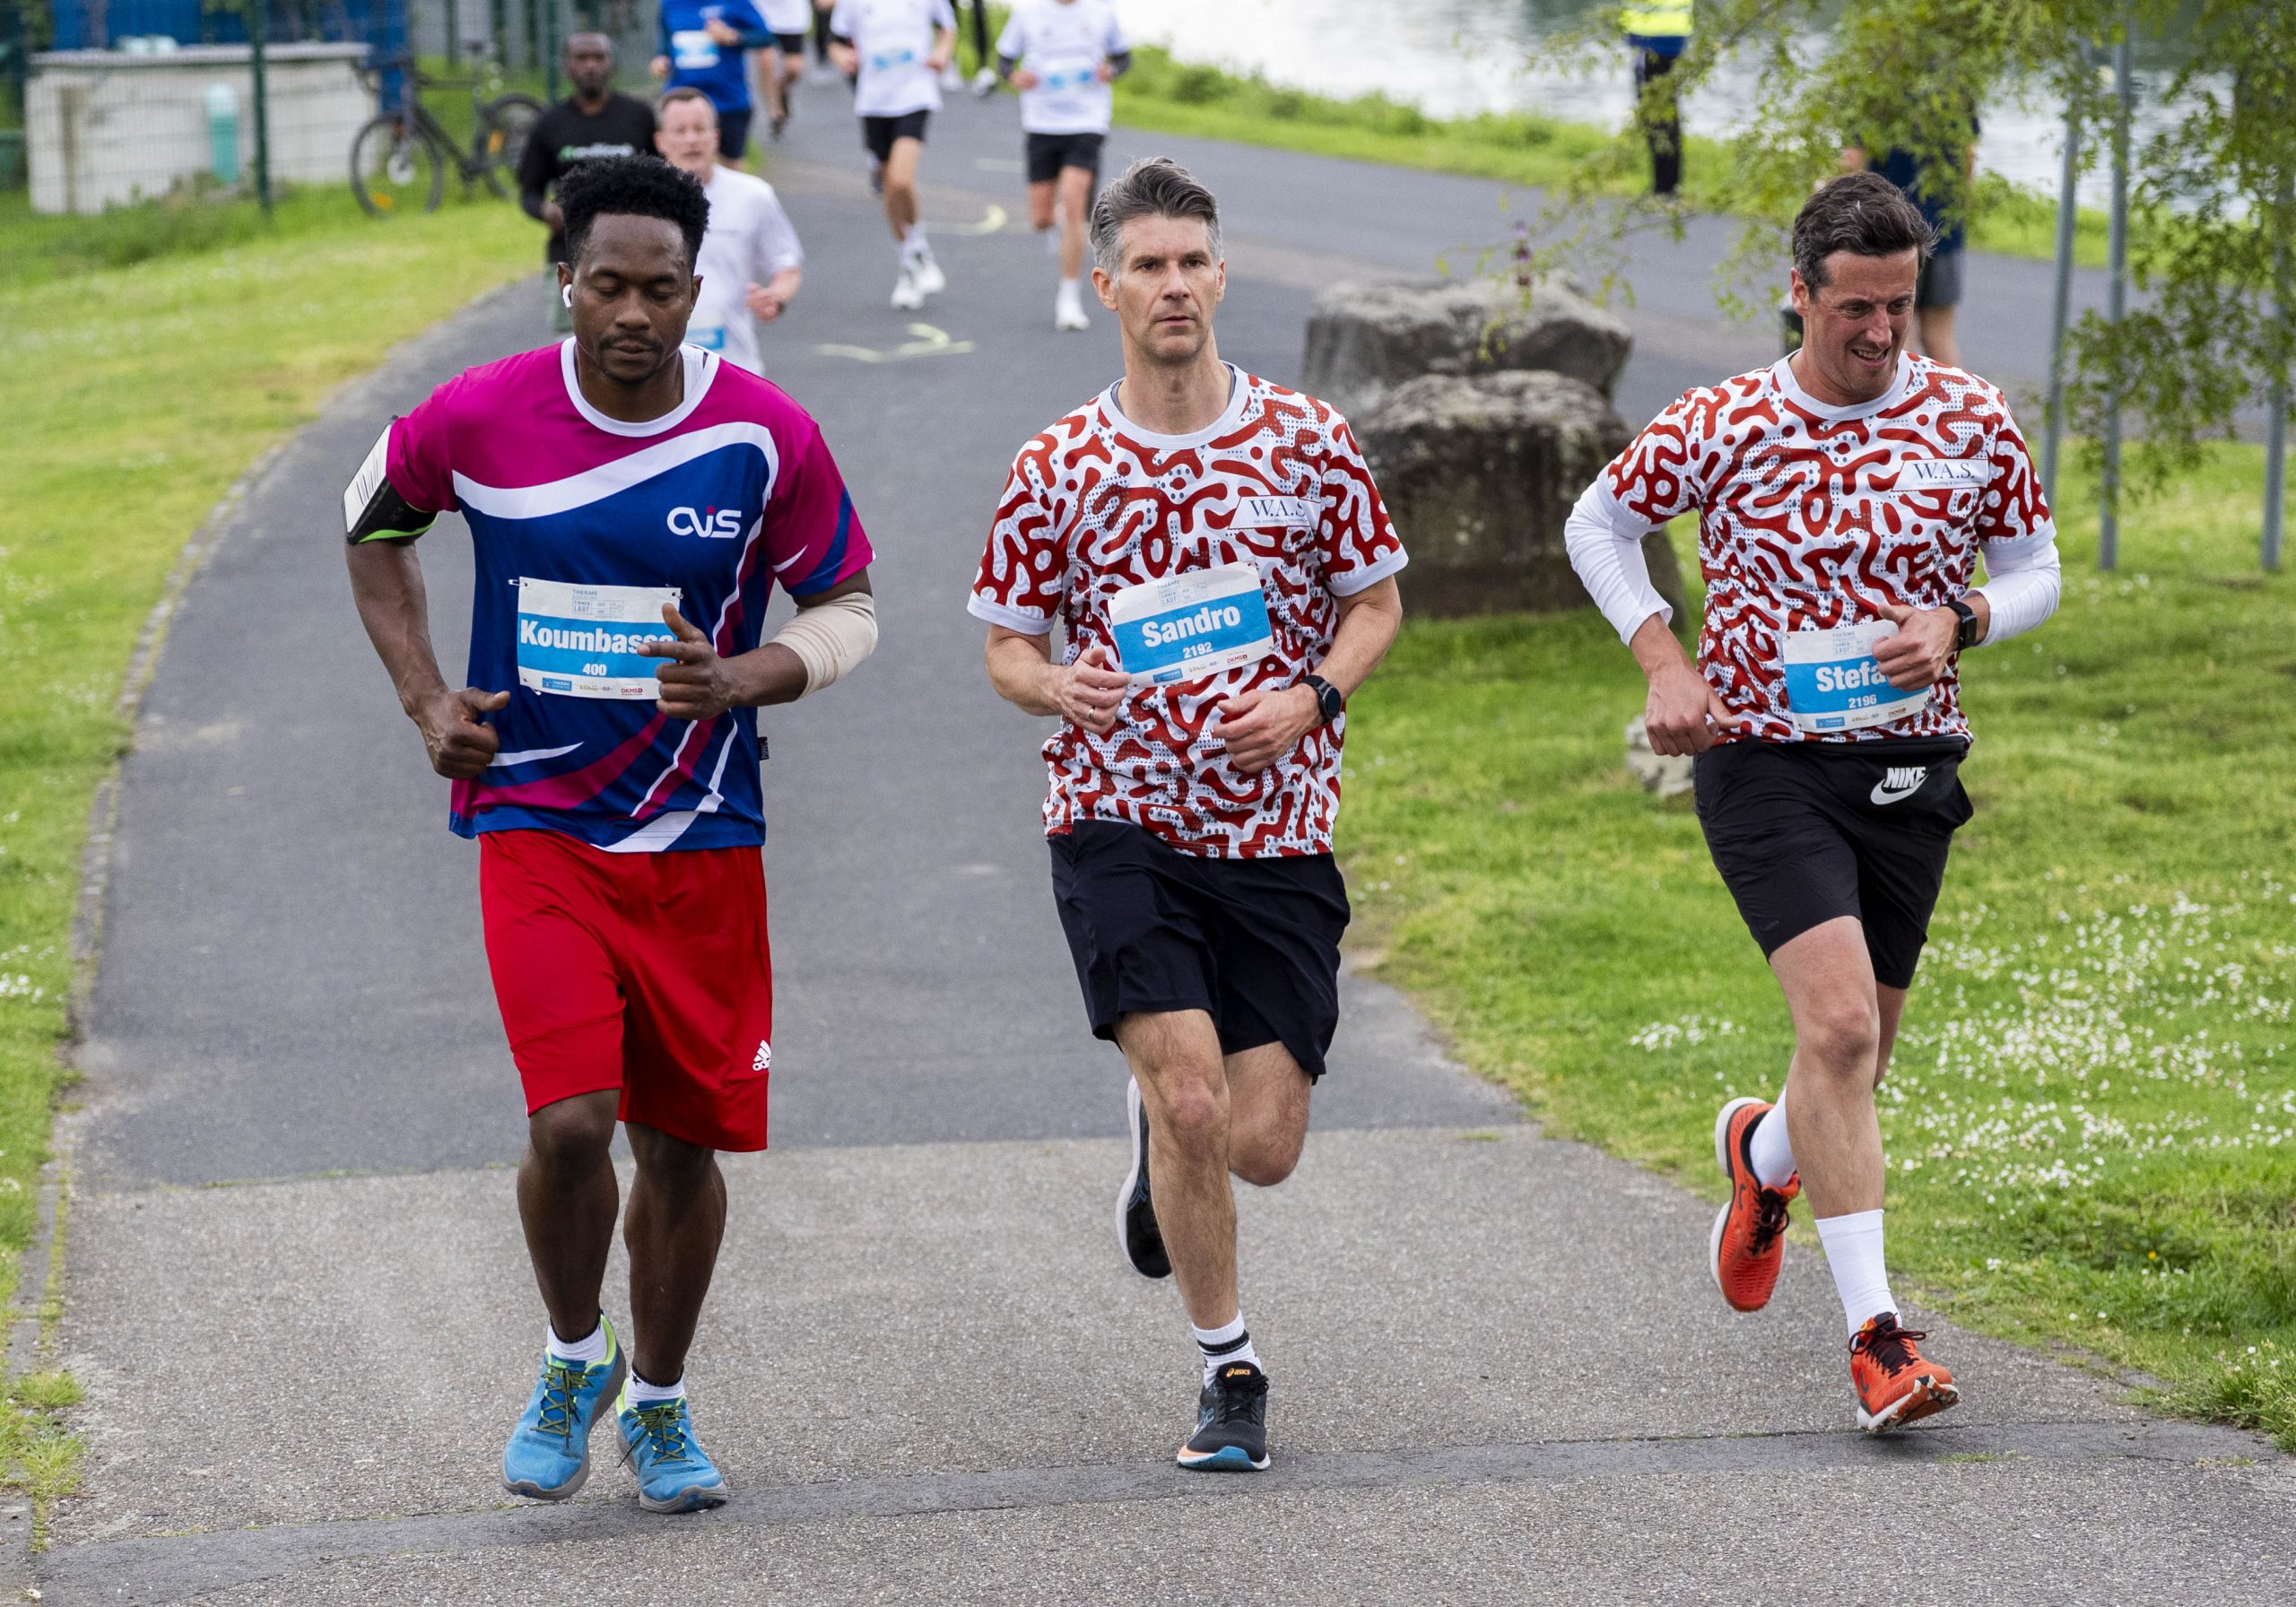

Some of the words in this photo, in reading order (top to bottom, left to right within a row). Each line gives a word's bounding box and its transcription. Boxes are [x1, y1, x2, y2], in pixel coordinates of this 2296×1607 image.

[1912, 462, 1975, 480] W.A.S.
[1142, 606, 1241, 647] Sandro
[520, 620, 674, 655] Koumbas
[1182, 641, 1213, 659] 2192
[582, 663, 607, 676] 400
[1815, 661, 1889, 692] Stefa
[1848, 694, 1878, 709] 2196
[1883, 766, 1926, 789] NIKE
